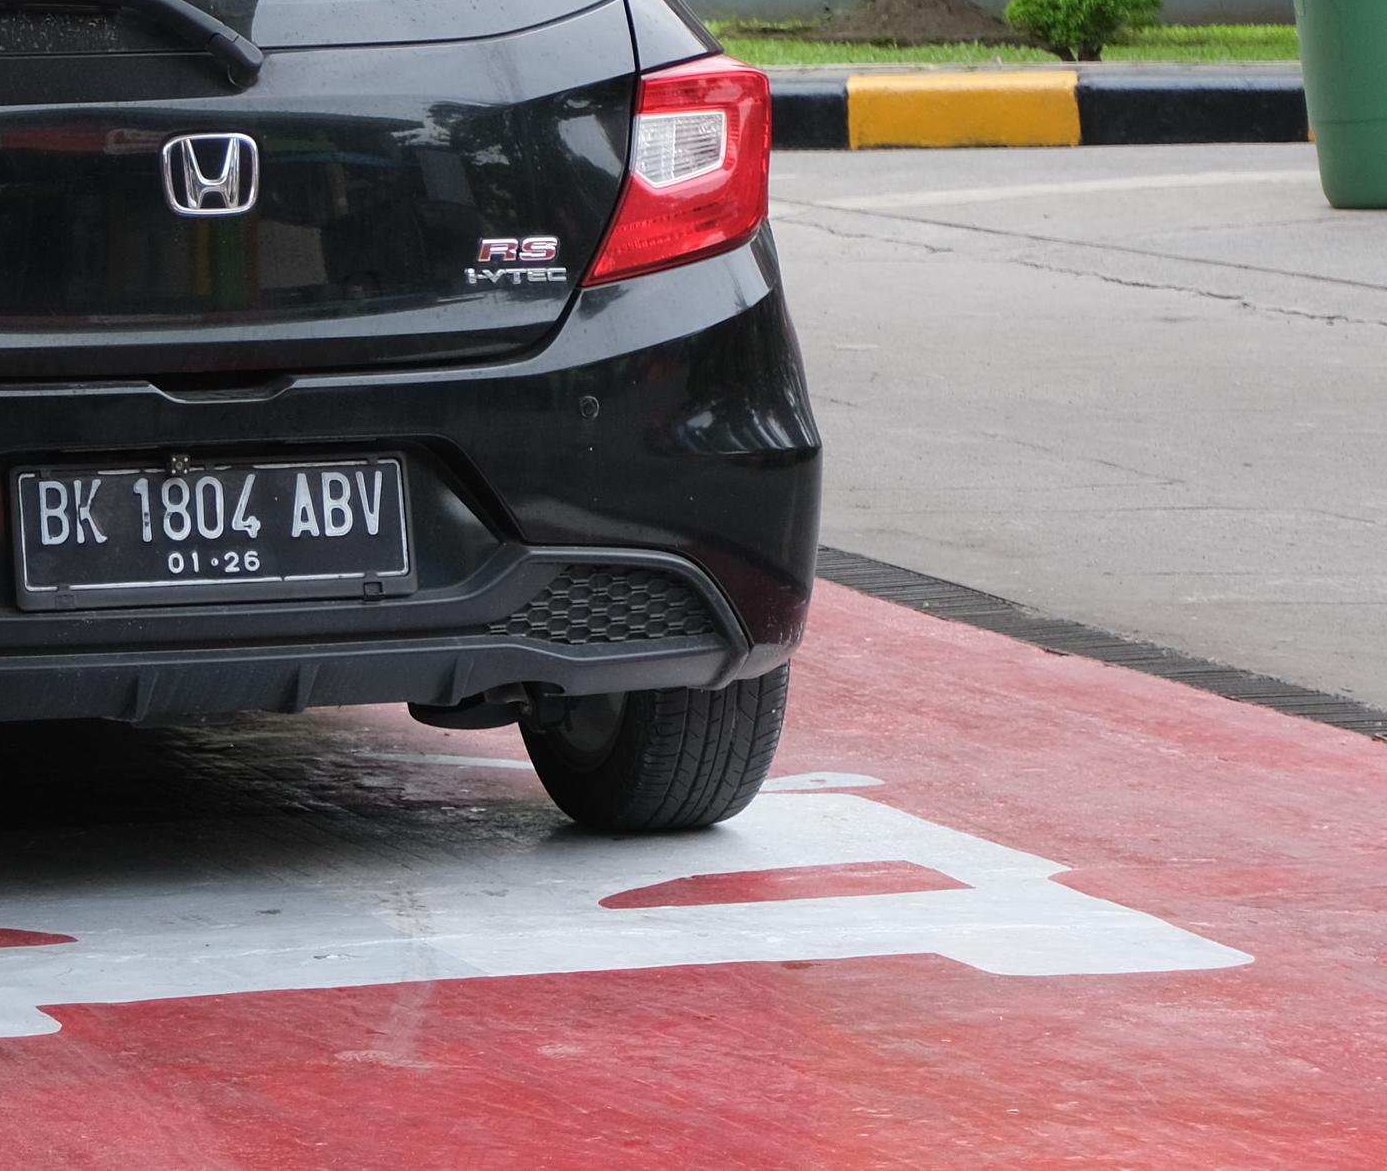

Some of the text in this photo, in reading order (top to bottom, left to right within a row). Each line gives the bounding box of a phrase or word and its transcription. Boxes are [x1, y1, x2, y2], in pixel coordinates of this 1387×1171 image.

[477, 236, 559, 262] RS
[464, 267, 568, 285] i-VTEC
[39, 470, 384, 546] BK 1804 ABV
